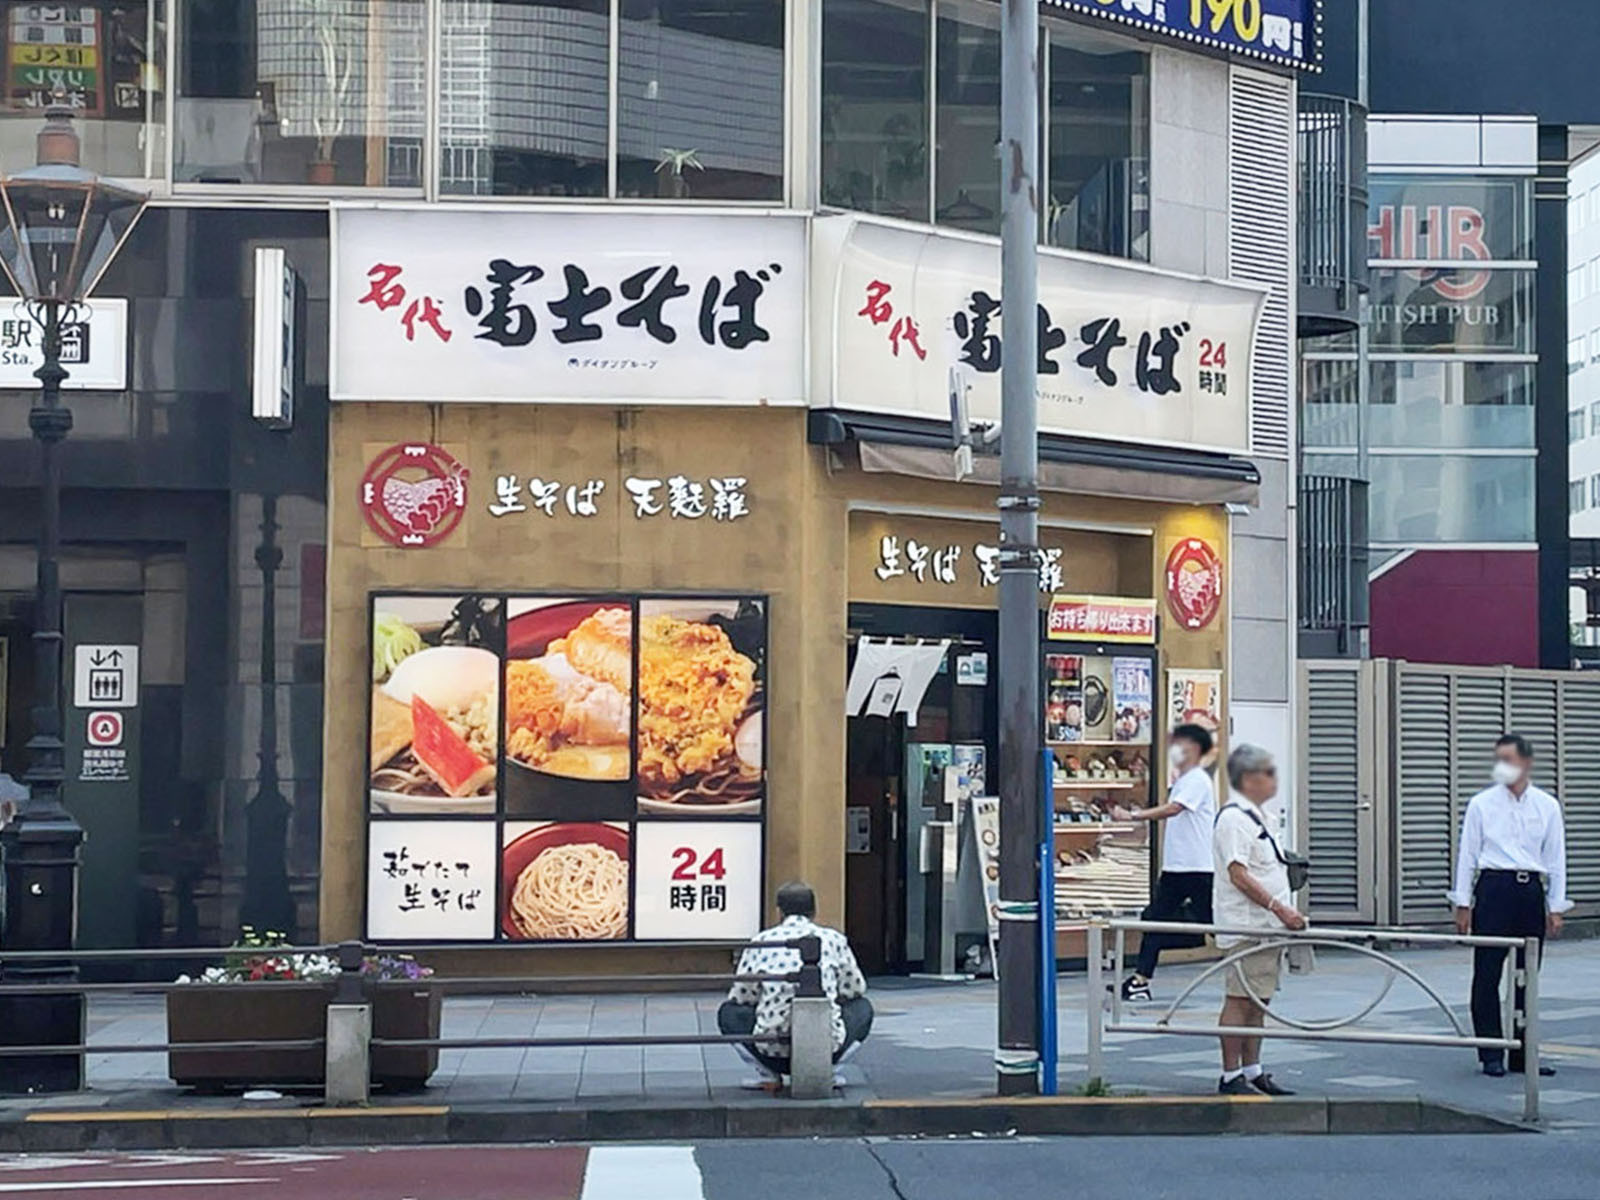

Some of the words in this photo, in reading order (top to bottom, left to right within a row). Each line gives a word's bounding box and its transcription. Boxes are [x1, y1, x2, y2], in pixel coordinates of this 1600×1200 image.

[357, 262, 453, 343] 名代
[1449, 304, 1500, 325] PUB
[2, 319, 32, 348] 駅
[857, 280, 928, 361] 名代
[2, 350, 34, 365] Sta.
[1199, 339, 1227, 369] 24
[1198, 371, 1227, 396] 時間
[488, 475, 605, 517] 生そば
[877, 535, 961, 584] 生そば
[974, 544, 1065, 593] 天羅
[671, 847, 727, 880] 24
[398, 882, 481, 912] 生そば
[669, 885, 727, 912] 時間
